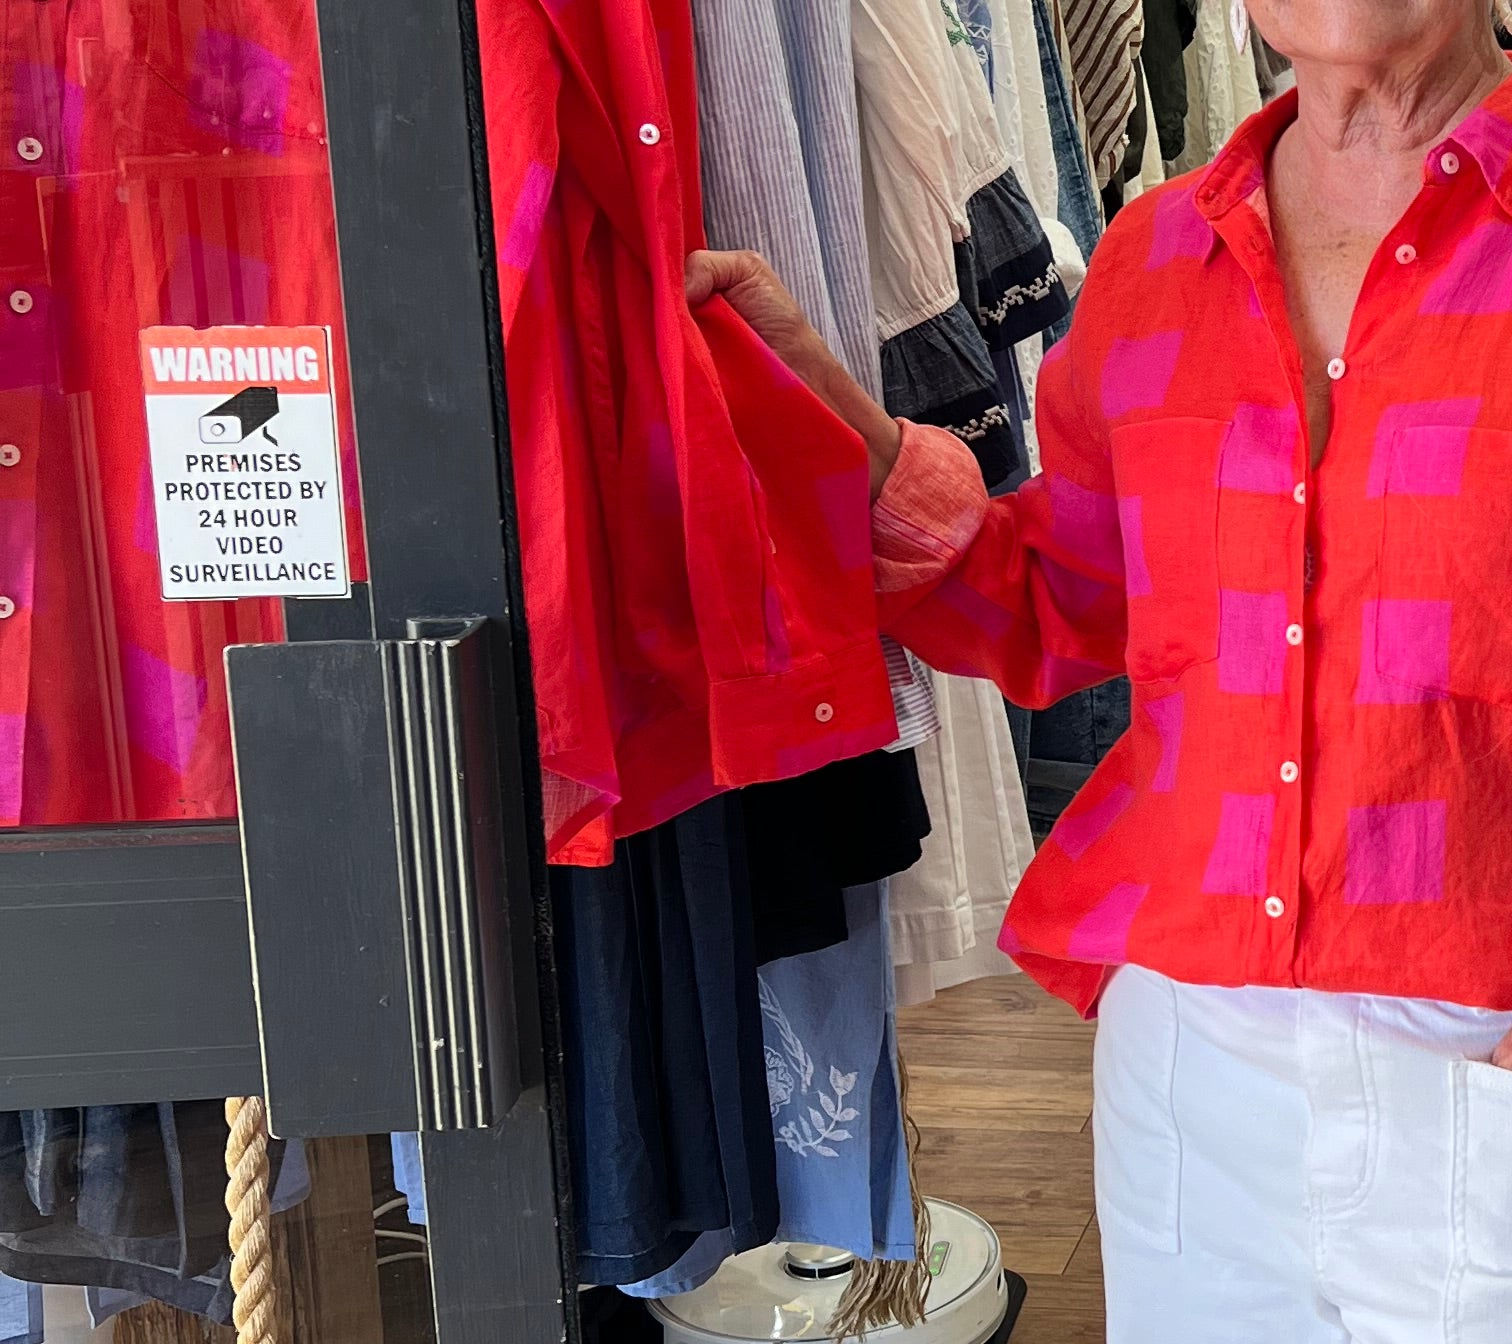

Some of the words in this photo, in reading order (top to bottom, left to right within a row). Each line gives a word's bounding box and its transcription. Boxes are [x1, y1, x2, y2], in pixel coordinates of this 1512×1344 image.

[149, 346, 319, 382] WARNING
[185, 453, 302, 473] PREMISES
[164, 481, 292, 501] PROTECTED
[300, 481, 327, 500] BY
[199, 510, 227, 528] 24
[234, 509, 298, 528] HOUR
[216, 536, 284, 555] VIDEO
[169, 562, 337, 583] SURVEILLANCE
